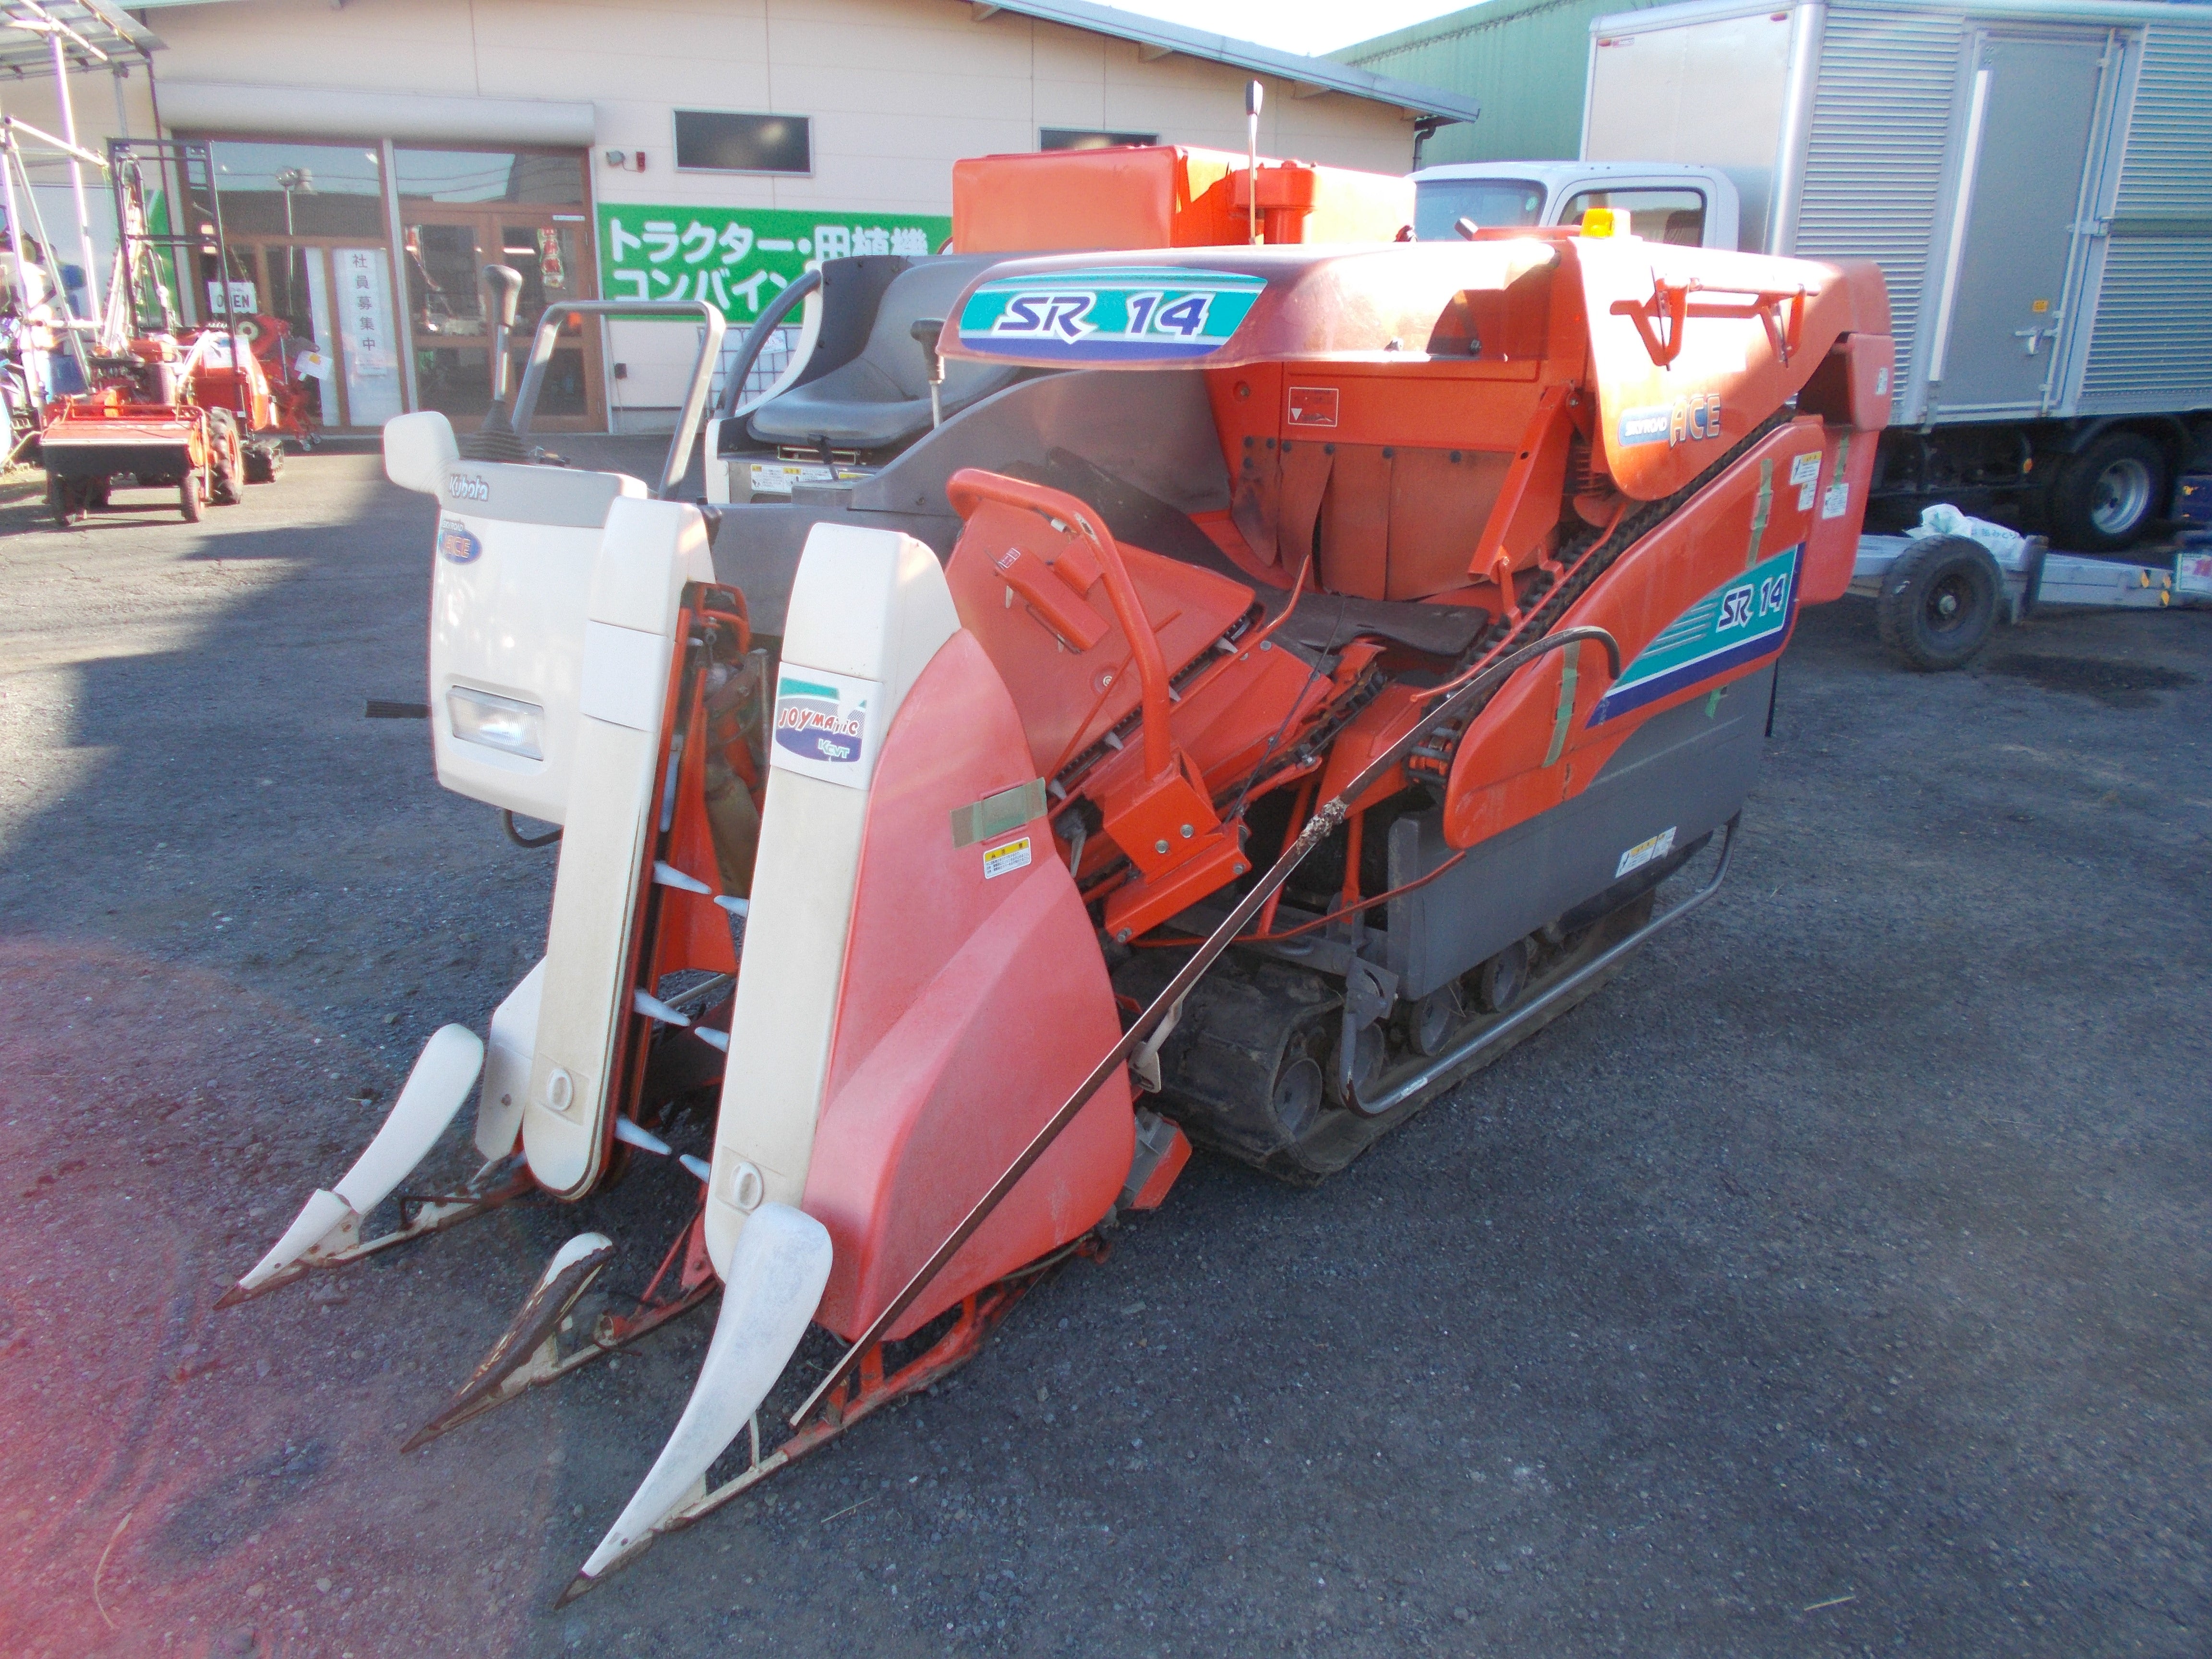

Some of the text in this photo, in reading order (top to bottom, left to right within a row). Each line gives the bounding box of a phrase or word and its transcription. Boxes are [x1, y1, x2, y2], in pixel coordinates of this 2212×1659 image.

[216, 294, 250, 307] OEN
[353, 254, 375, 351] 社員募集中
[992, 292, 1215, 343] SR 14
[1625, 394, 1720, 447] SKYROAD ACE
[449, 474, 489, 501] Kubota
[445, 535, 471, 558] ACE
[1716, 574, 1787, 632] SR 14
